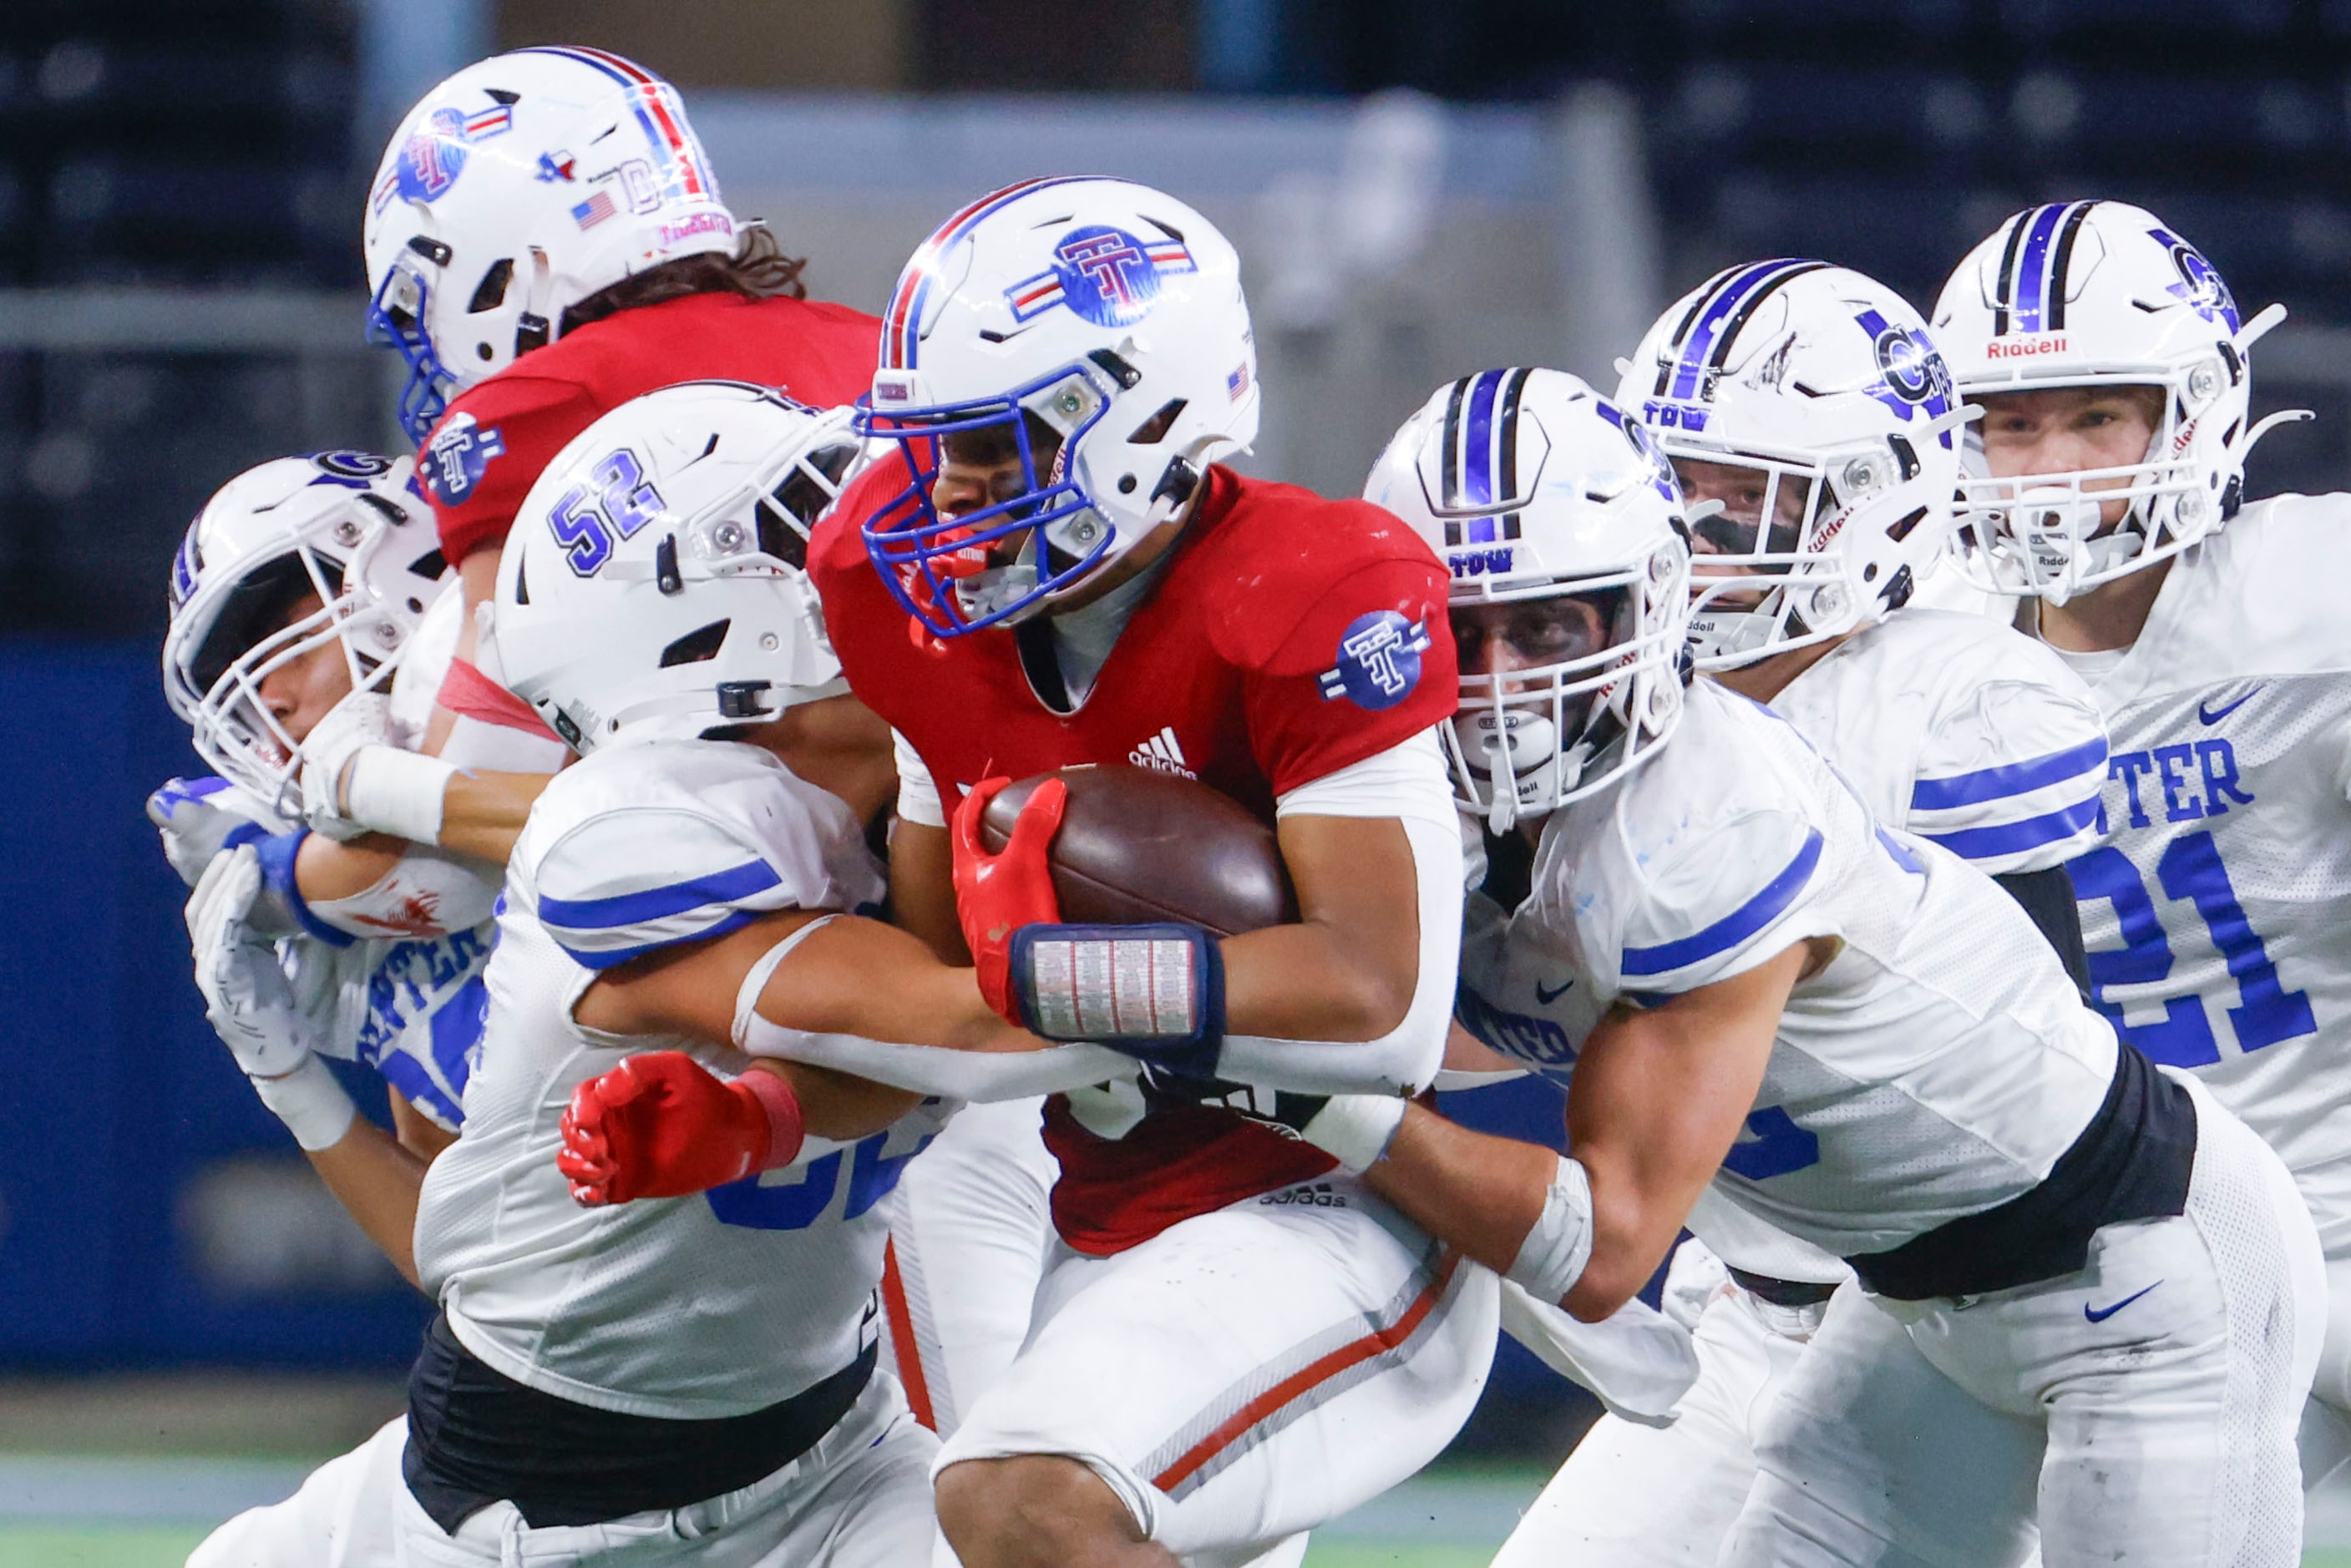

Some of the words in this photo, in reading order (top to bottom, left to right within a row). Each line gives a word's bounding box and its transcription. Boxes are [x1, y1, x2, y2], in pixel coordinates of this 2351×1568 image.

[1987, 337, 2067, 358] Riddell
[1643, 400, 1712, 432] TOW
[546, 447, 668, 579] 52
[1448, 547, 1513, 578] TOW
[1342, 620, 1406, 696] TT
[2063, 830, 2318, 1069] 21
